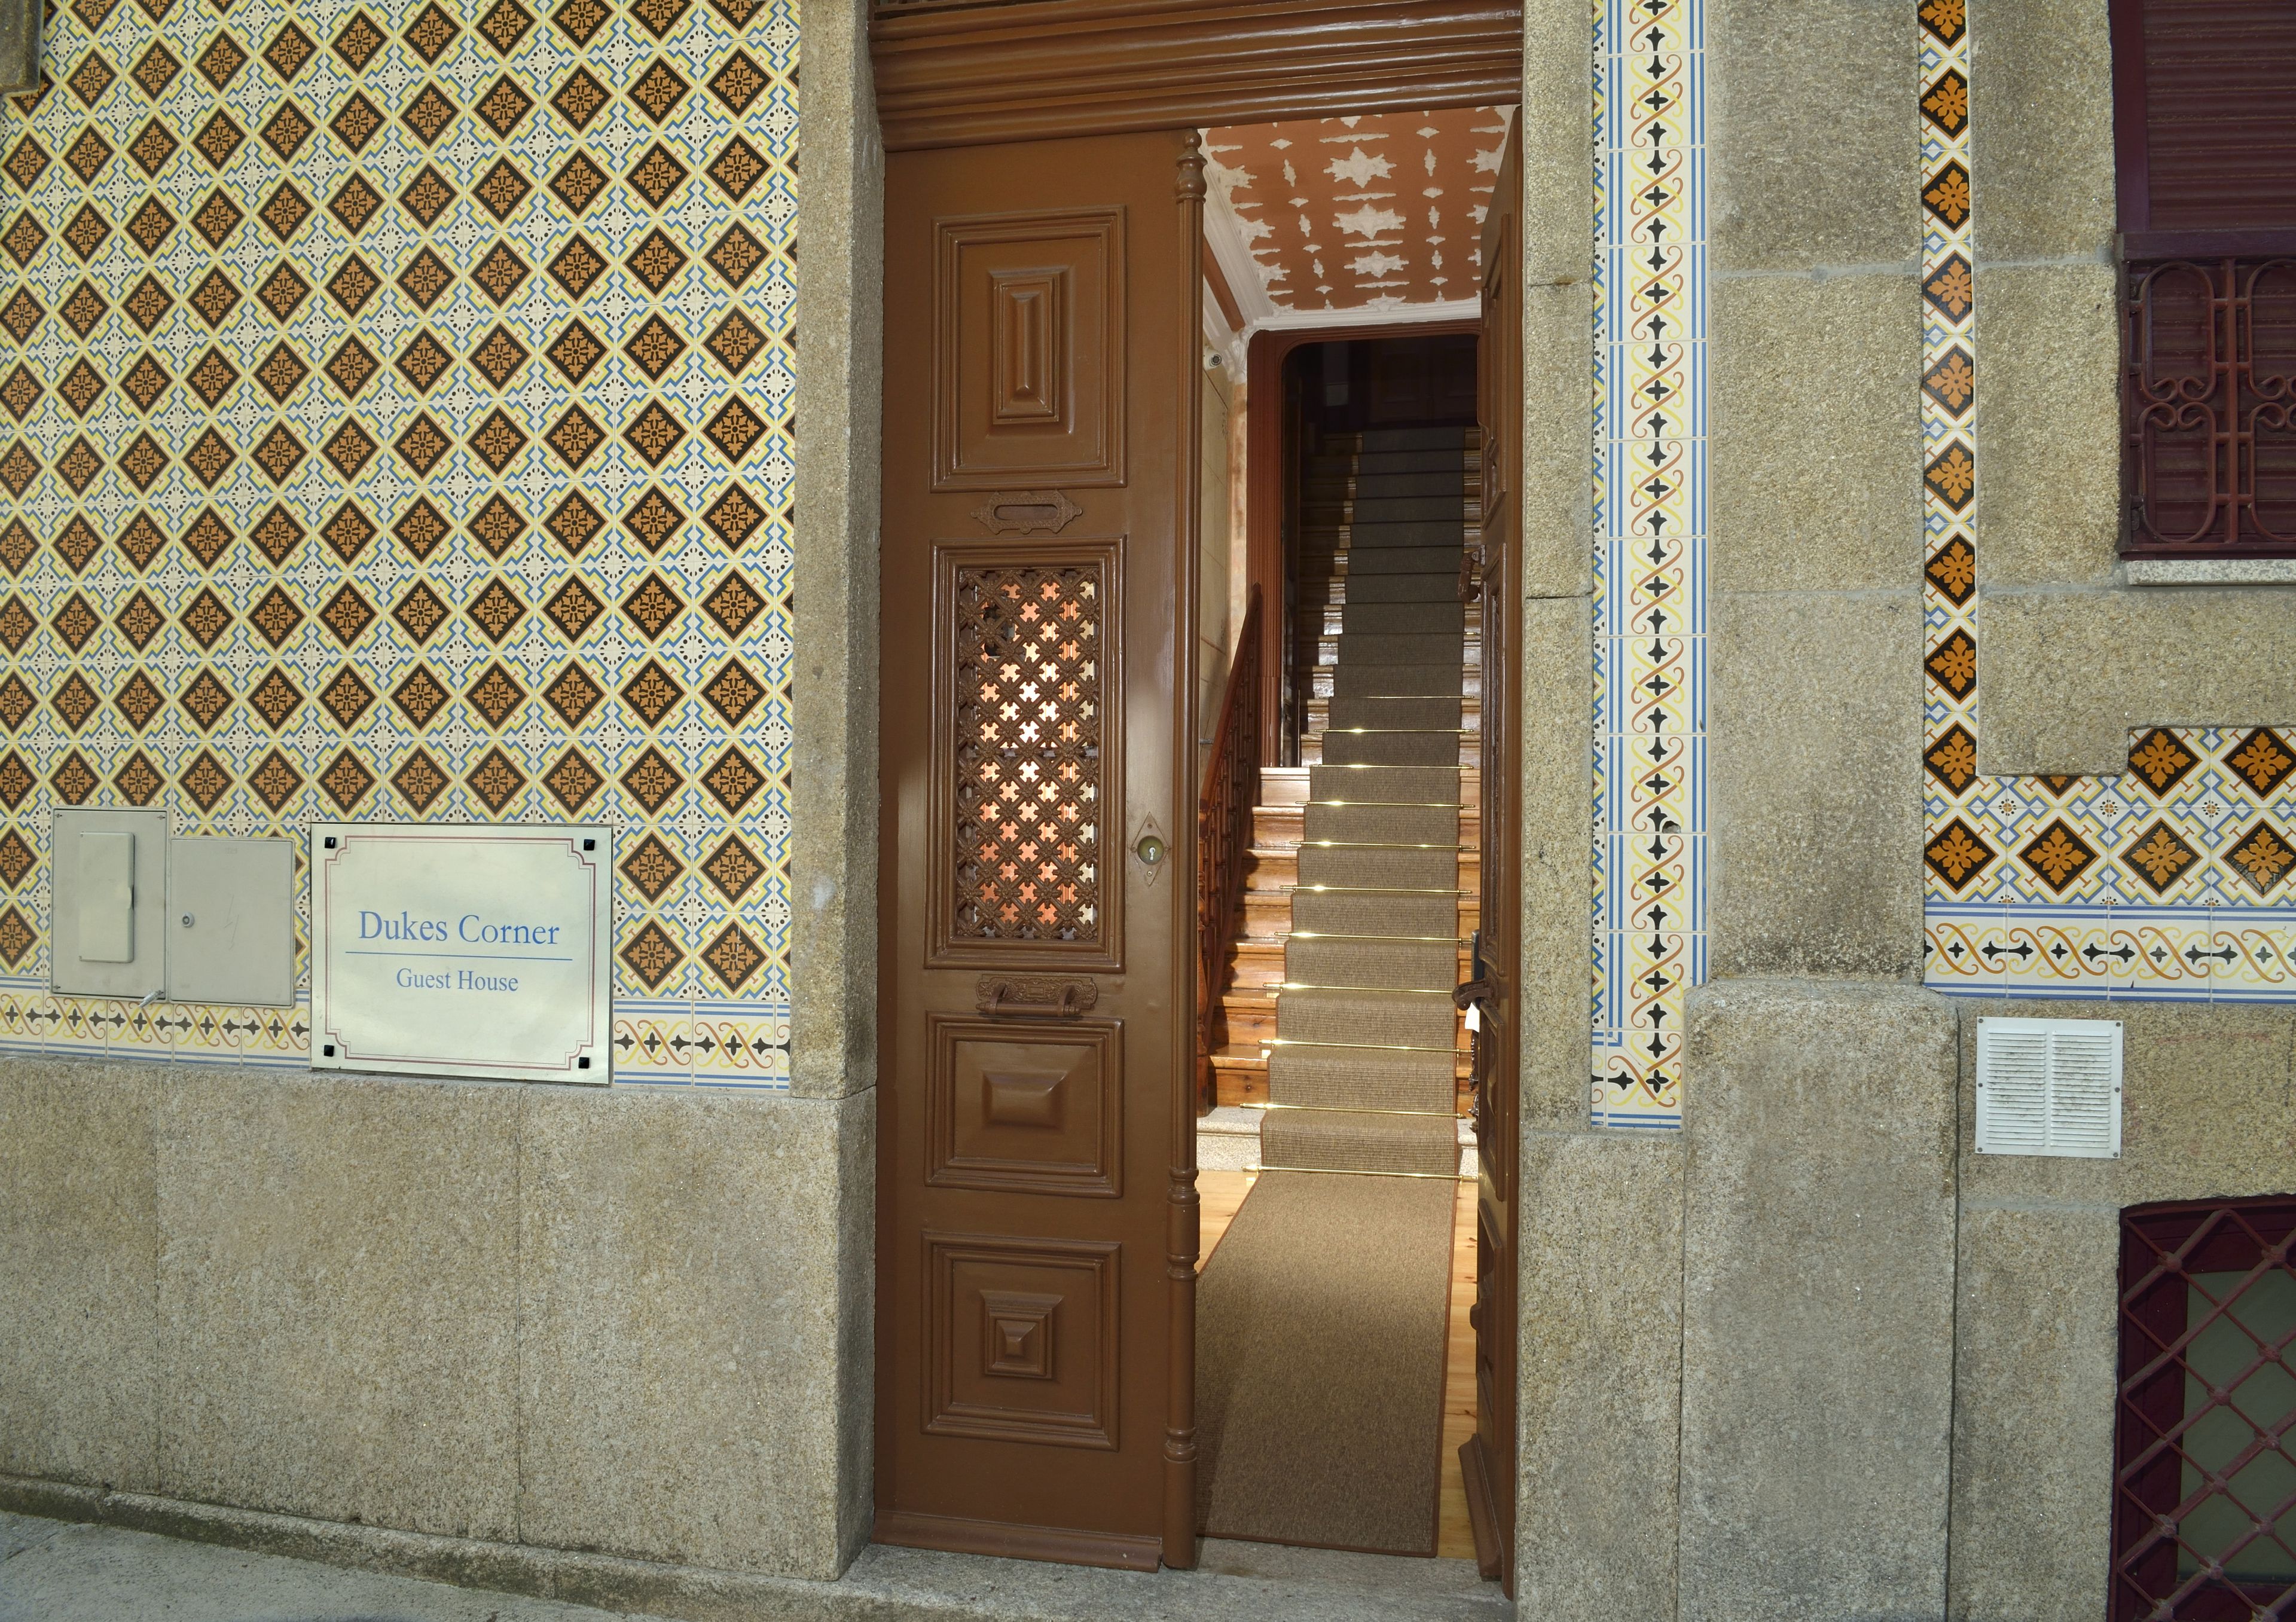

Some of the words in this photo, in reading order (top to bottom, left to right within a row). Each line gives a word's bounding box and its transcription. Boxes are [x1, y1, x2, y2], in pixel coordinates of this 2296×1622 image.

[359, 911, 448, 941] Dukes
[459, 915, 560, 945] Corner
[396, 968, 451, 989] Guest
[457, 970, 518, 992] House
